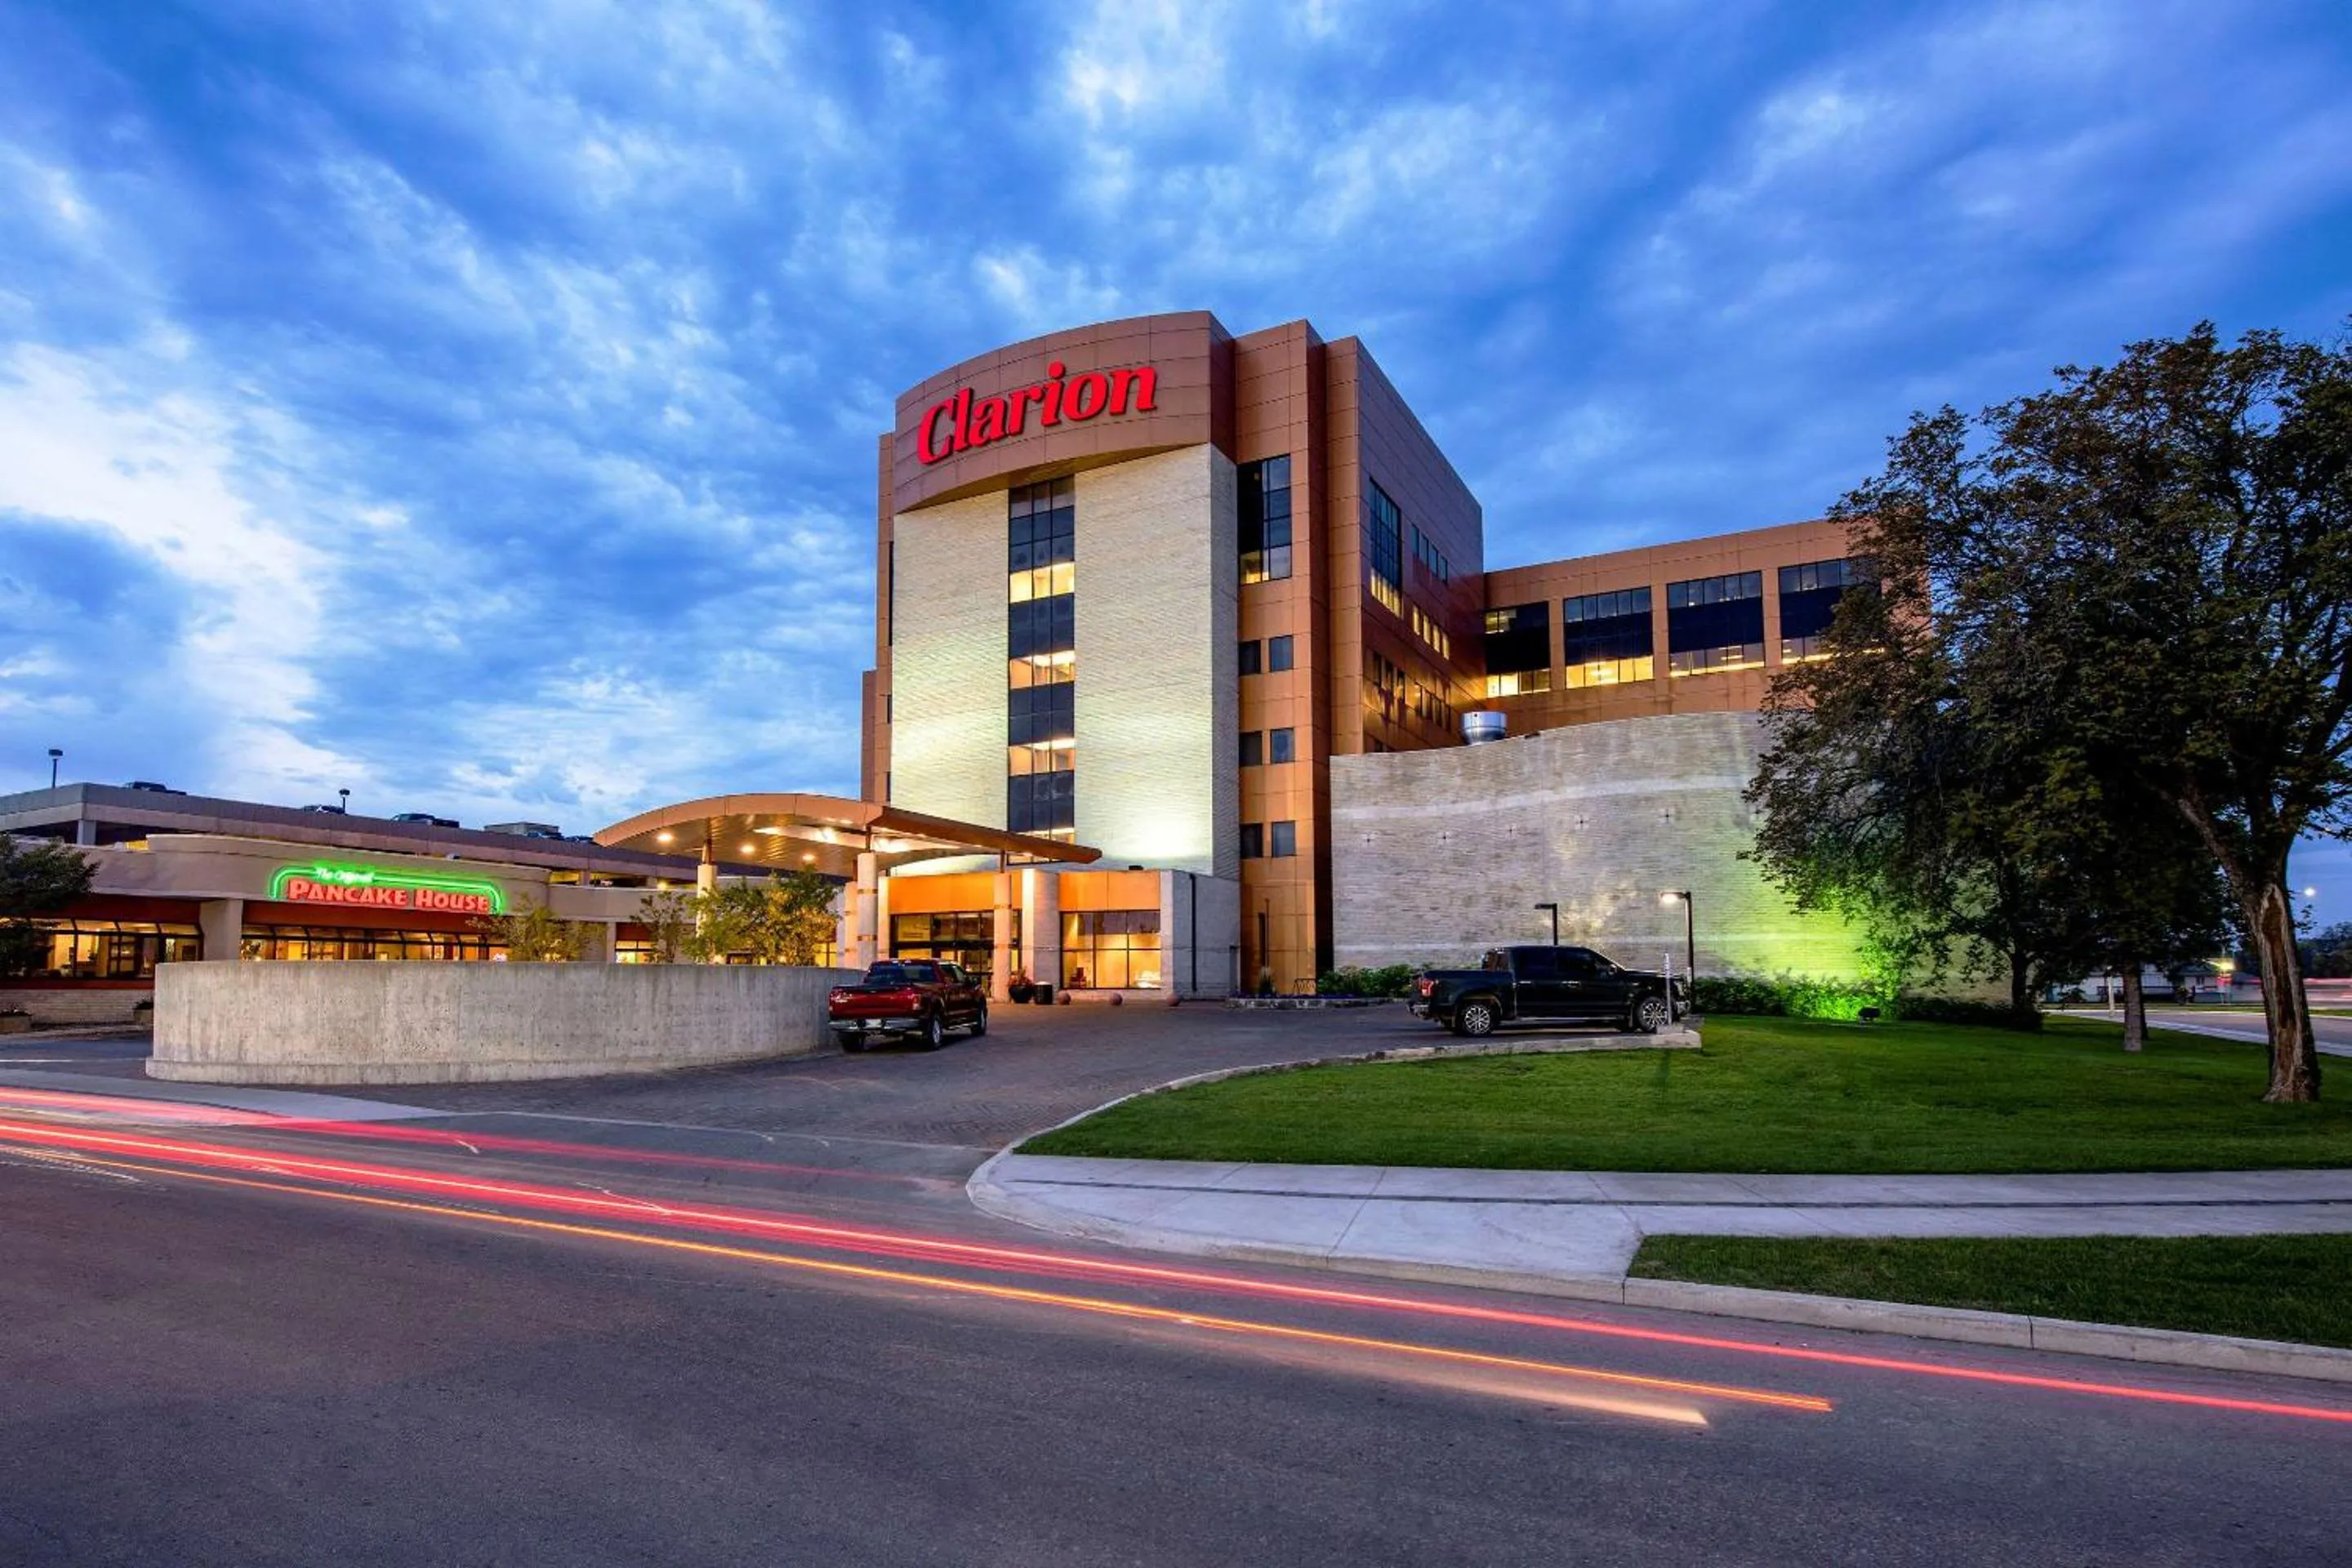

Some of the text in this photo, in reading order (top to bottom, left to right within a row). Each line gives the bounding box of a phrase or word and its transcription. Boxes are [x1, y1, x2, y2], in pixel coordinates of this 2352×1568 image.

[916, 361, 1157, 466] Clarion
[287, 878, 490, 913] PANCAKE HOUSE
